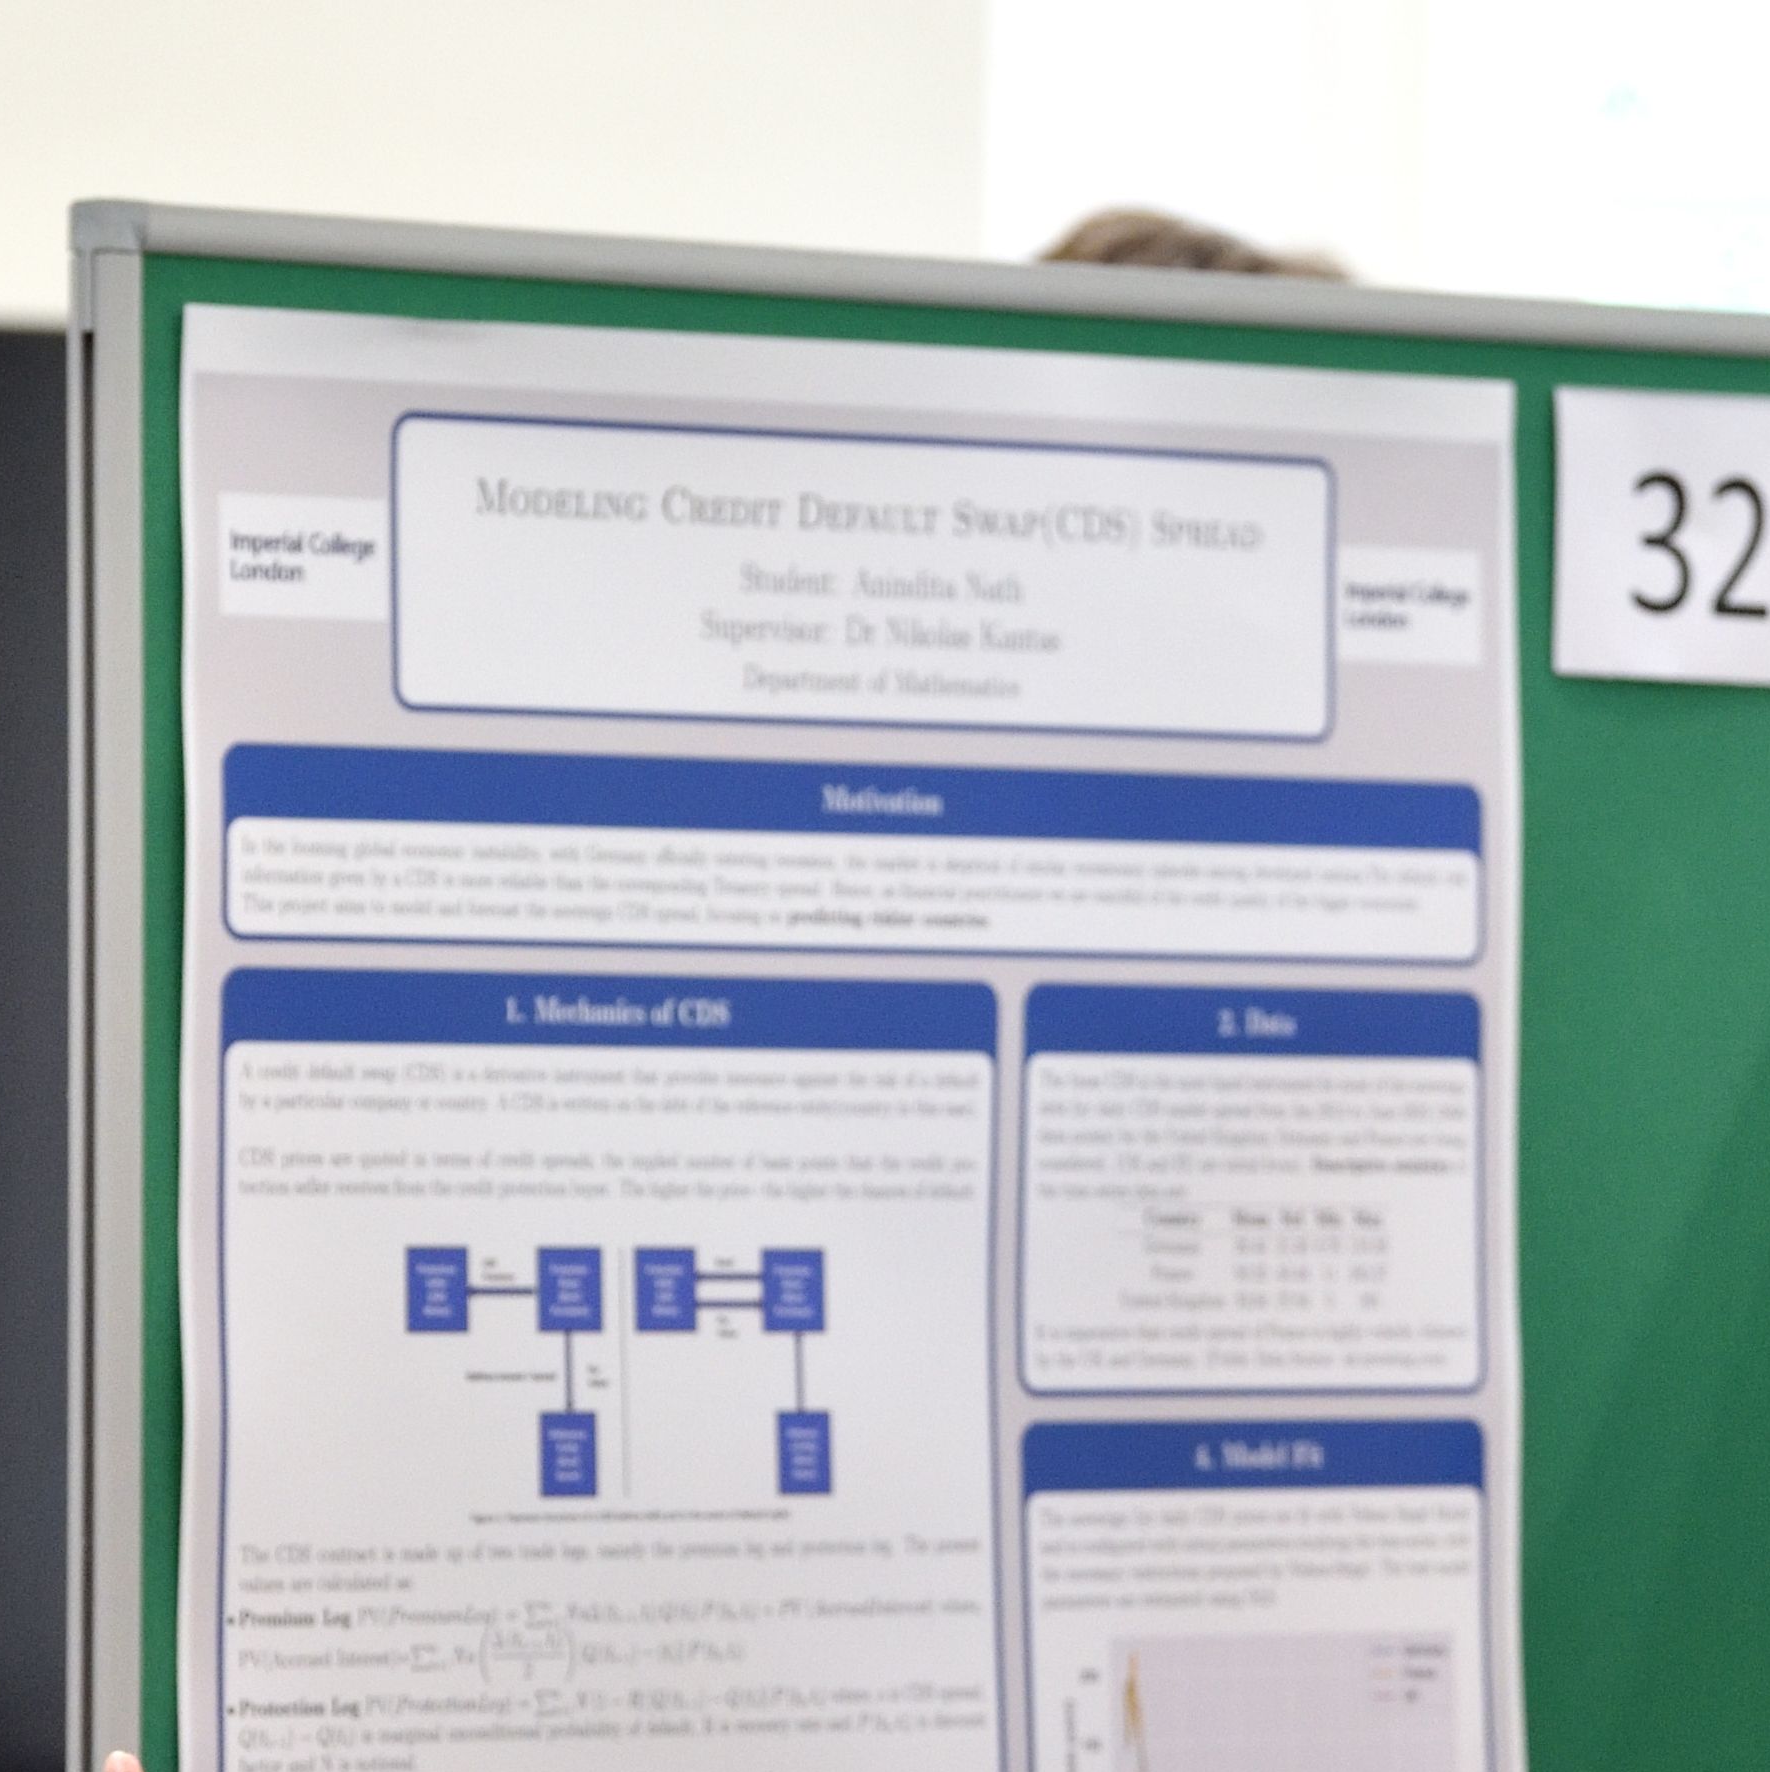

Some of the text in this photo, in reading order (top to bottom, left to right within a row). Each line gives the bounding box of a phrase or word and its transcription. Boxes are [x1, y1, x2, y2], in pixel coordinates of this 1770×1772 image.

[474, 475, 648, 524] MODELING
[661, 484, 782, 531] CREDIT
[798, 491, 940, 537] DEFAULT
[228, 531, 376, 560] Imperial College
[228, 560, 305, 584] London
[821, 783, 943, 818] Motivation
[534, 994, 647, 1027] Mechanics
[677, 997, 731, 1028] CDS
